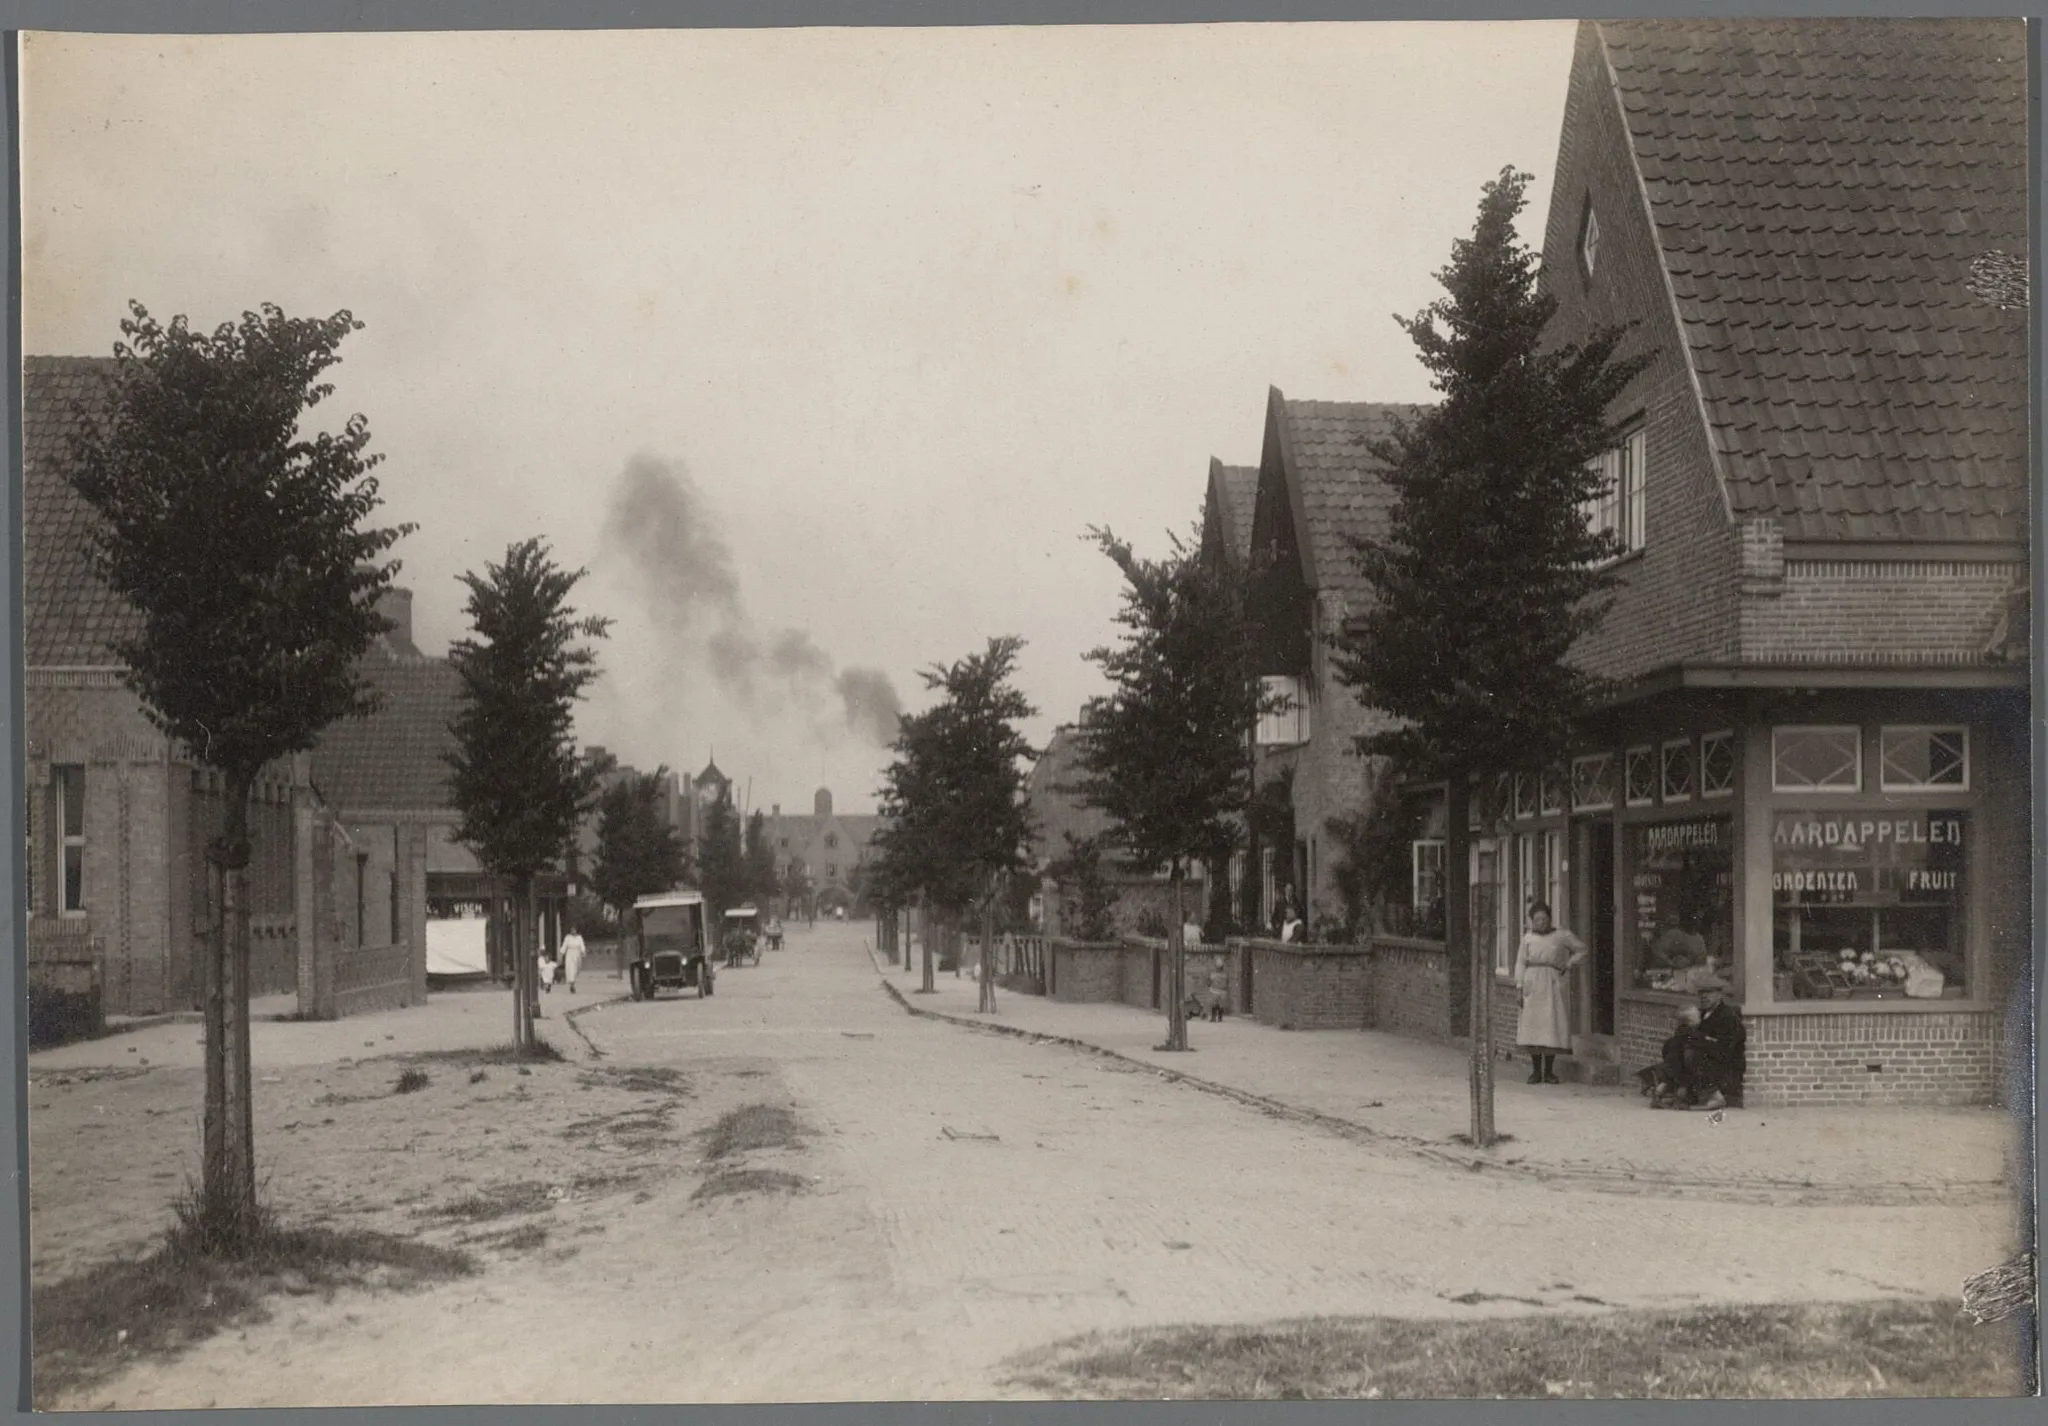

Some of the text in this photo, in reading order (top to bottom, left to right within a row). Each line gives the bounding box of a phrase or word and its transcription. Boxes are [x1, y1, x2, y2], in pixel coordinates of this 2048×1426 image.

[1648, 821, 1718, 849] AARDAPPELEN
[1774, 820, 1961, 846] AARDAPPELEN
[1772, 870, 1956, 891] GROENTEN FRUIT
